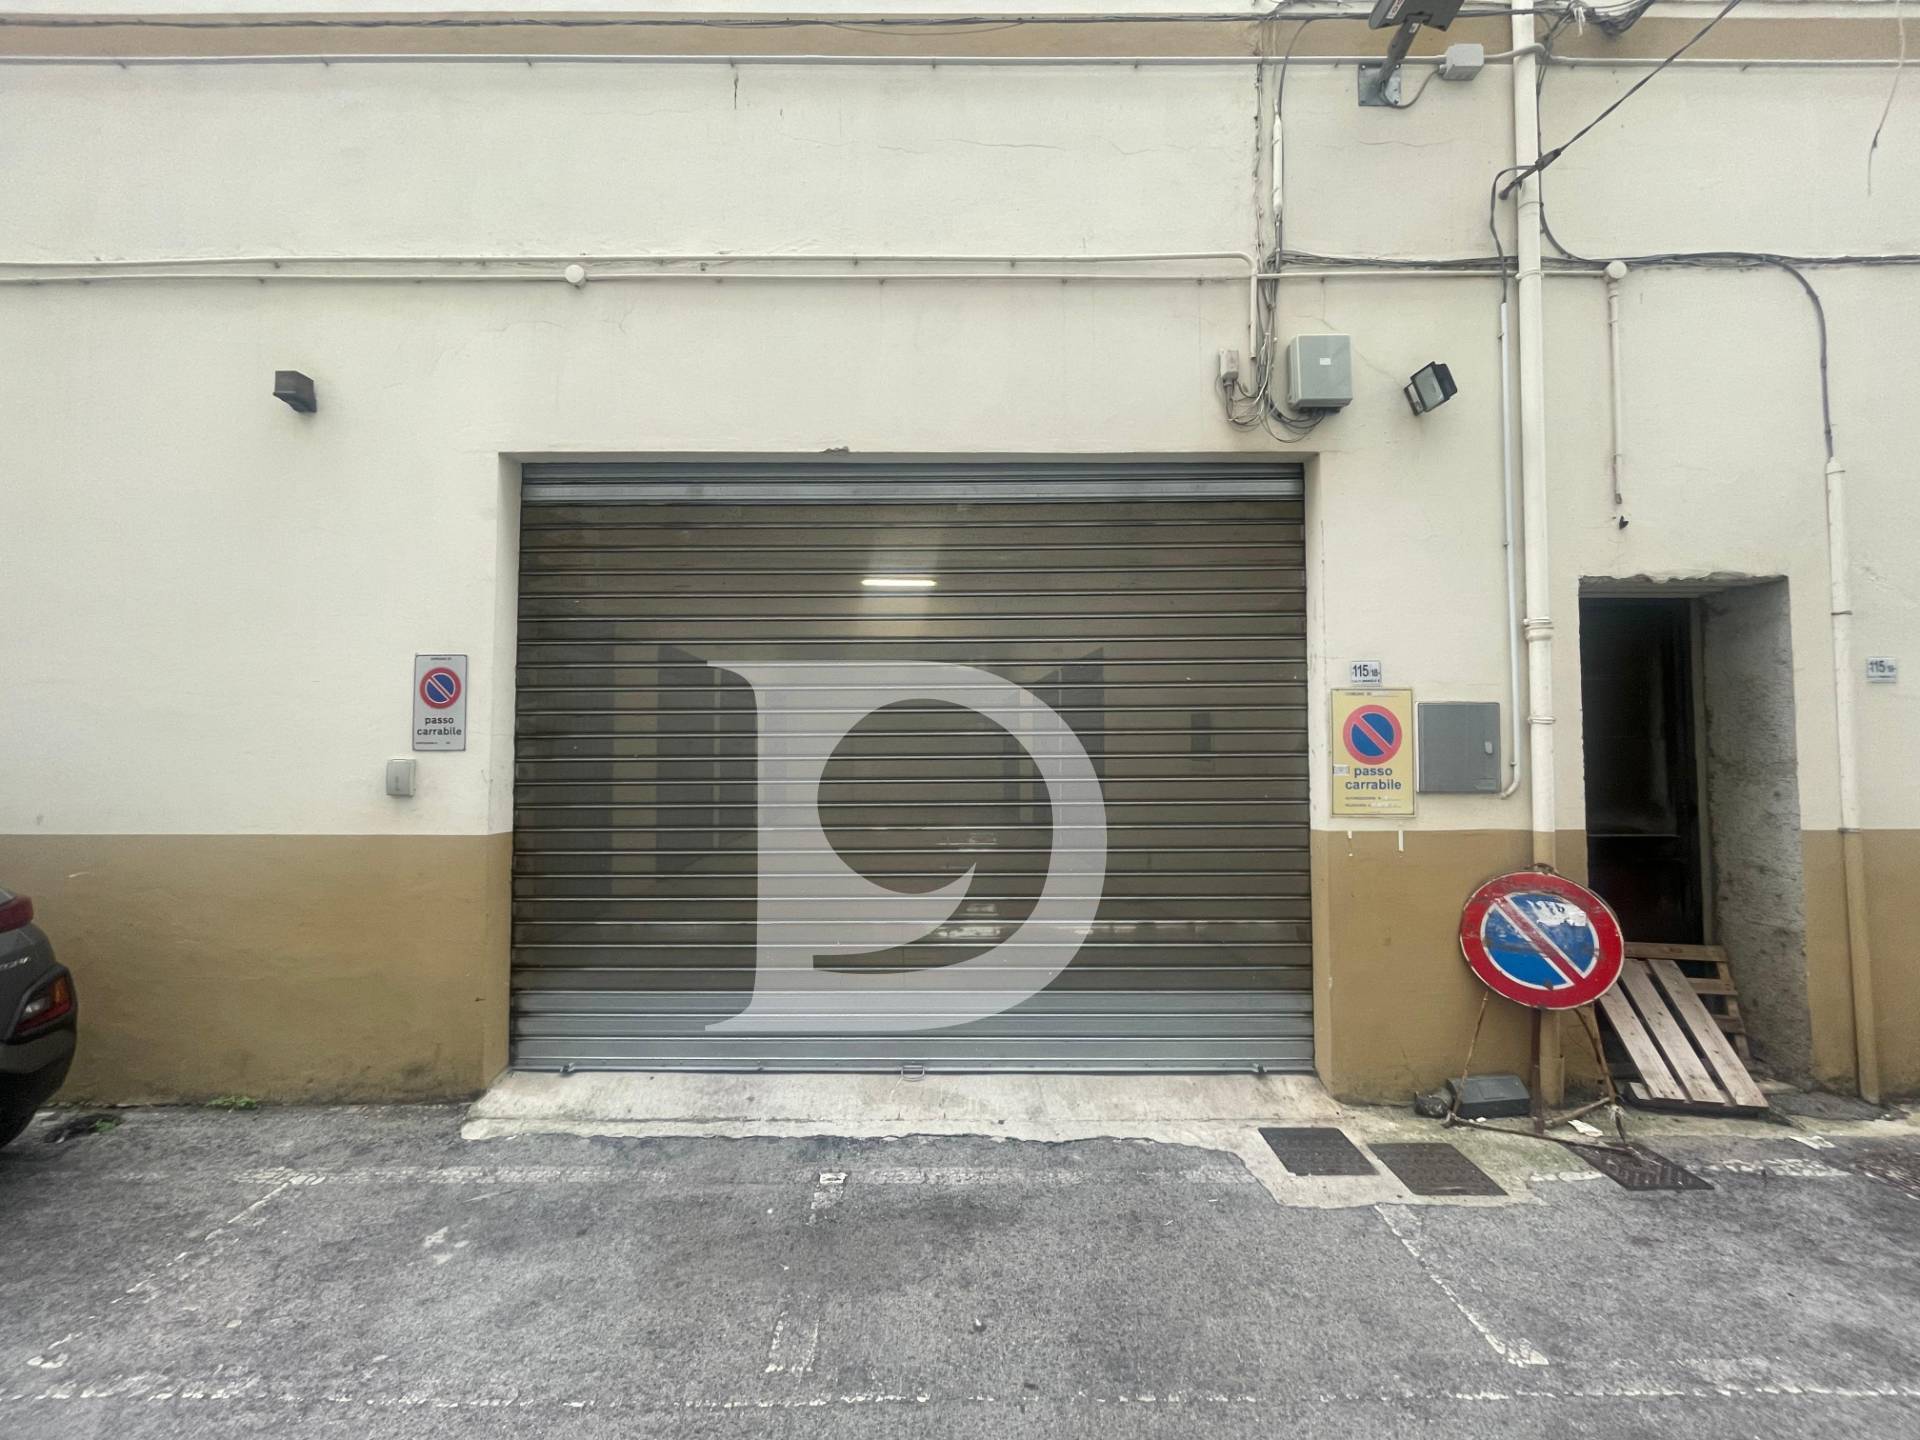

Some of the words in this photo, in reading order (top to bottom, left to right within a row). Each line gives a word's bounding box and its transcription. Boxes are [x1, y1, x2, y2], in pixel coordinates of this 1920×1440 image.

[1352, 664, 1369, 677] 115
[424, 717, 454, 726] passo
[416, 727, 462, 736] carrabile
[1354, 767, 1393, 778] passo
[1345, 778, 1402, 790] carrabile
